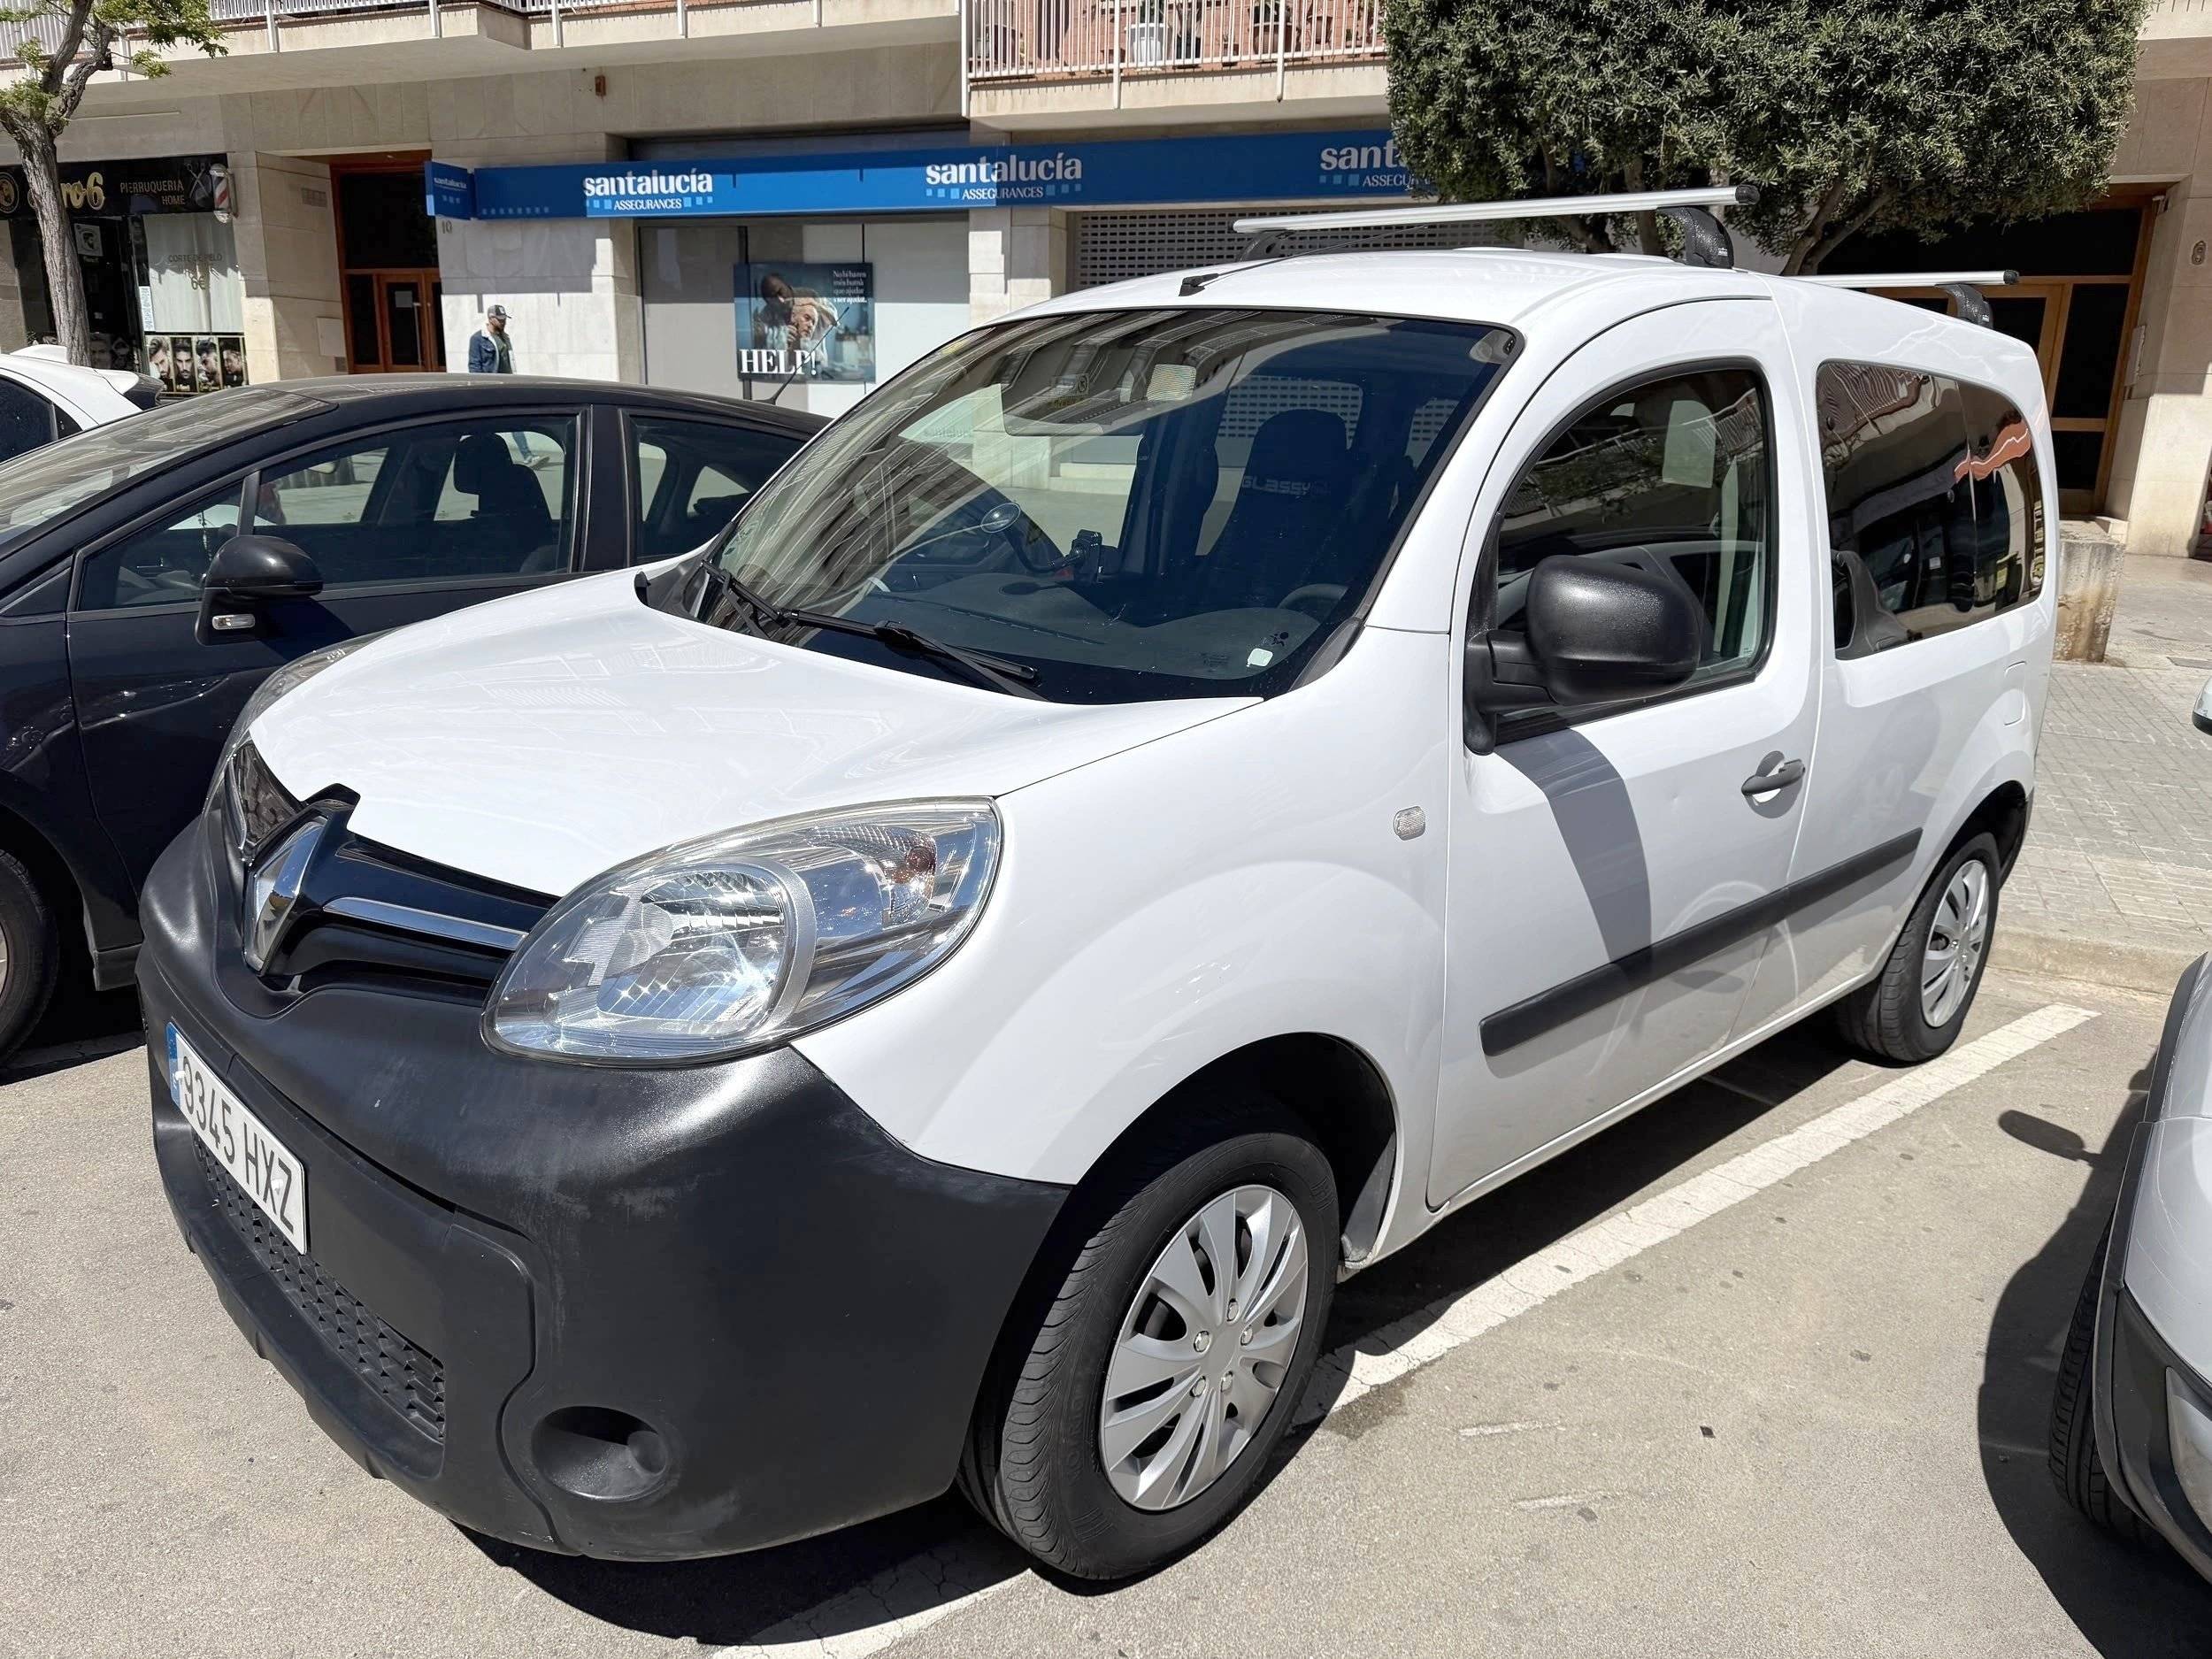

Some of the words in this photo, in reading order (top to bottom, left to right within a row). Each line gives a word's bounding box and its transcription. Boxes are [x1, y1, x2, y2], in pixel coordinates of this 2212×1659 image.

[926, 152, 1082, 184] santalucía
[1320, 139, 1409, 171] sant
[584, 168, 713, 196] santalucía
[962, 187, 1044, 200] ASSEGURANCES
[614, 197, 682, 211] ASSEGURANCES
[739, 349, 817, 376] HELP!
[182, 1056, 235, 1165] 9345
[243, 1122, 295, 1235] HXZ
